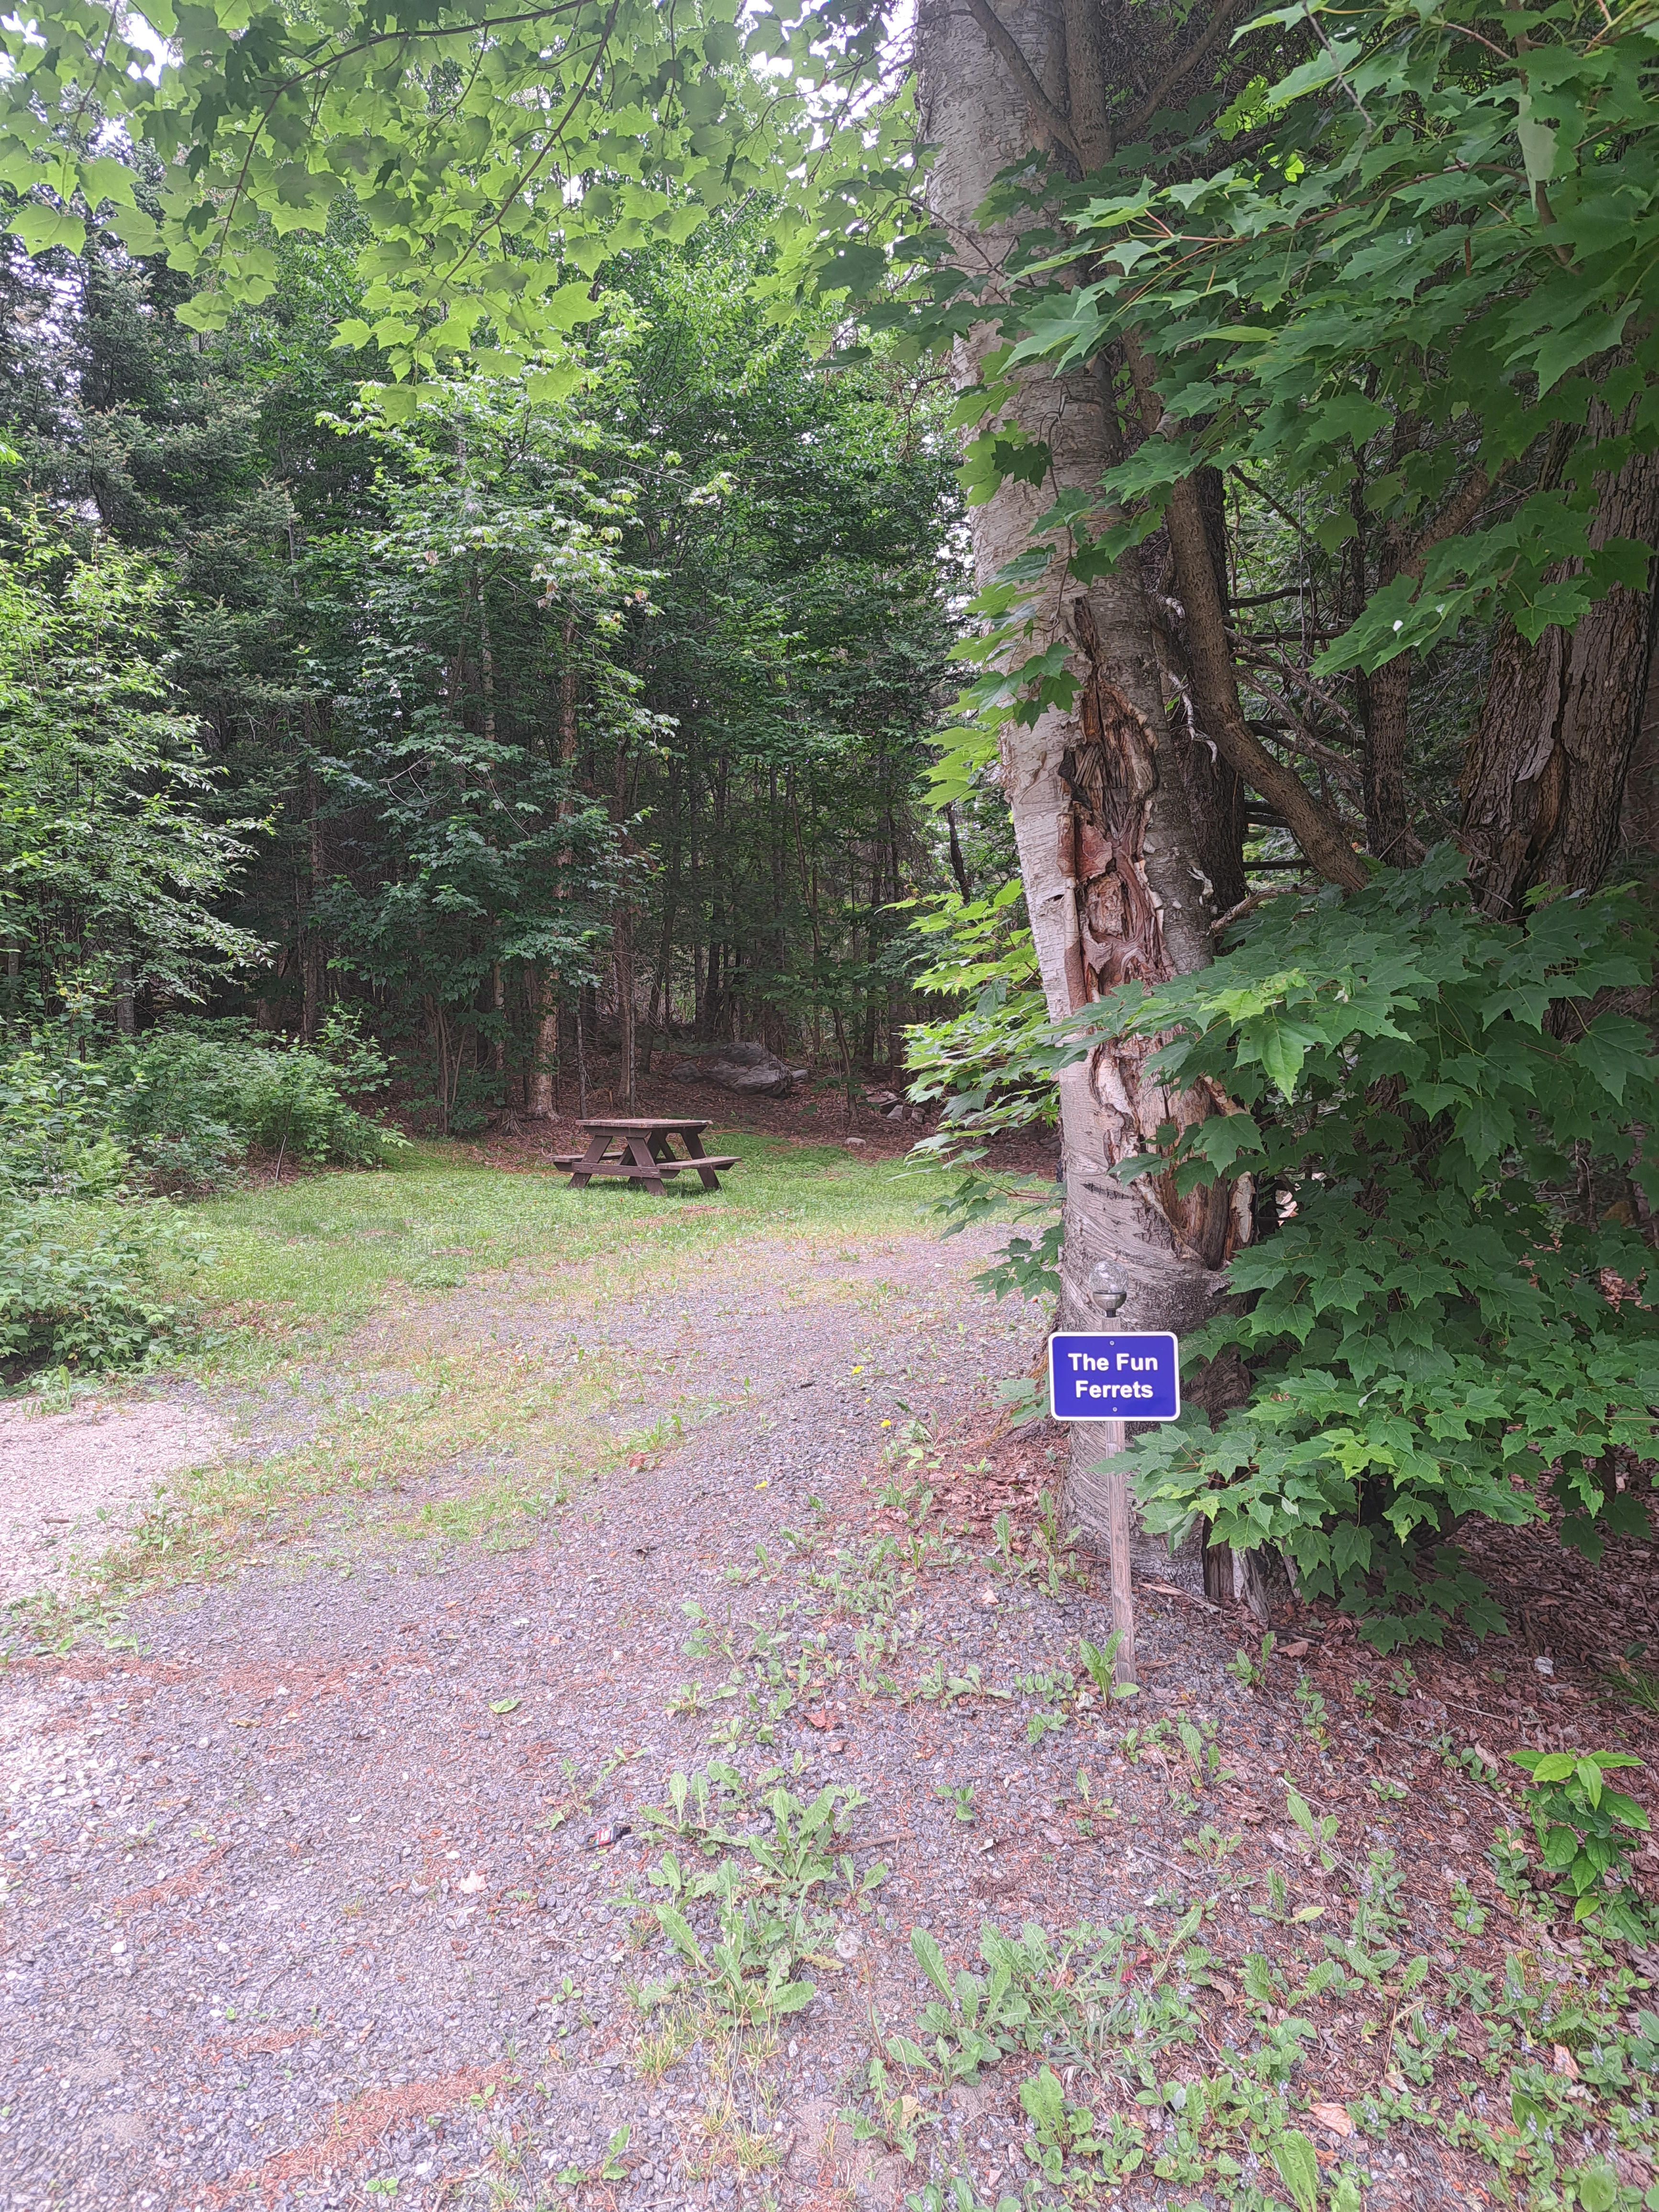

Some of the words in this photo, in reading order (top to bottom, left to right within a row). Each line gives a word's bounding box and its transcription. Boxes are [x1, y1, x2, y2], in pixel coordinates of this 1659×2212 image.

[1068, 1353, 1109, 1371] The
[1117, 1353, 1158, 1371] Fun
[1076, 1380, 1153, 1398] Ferrets
